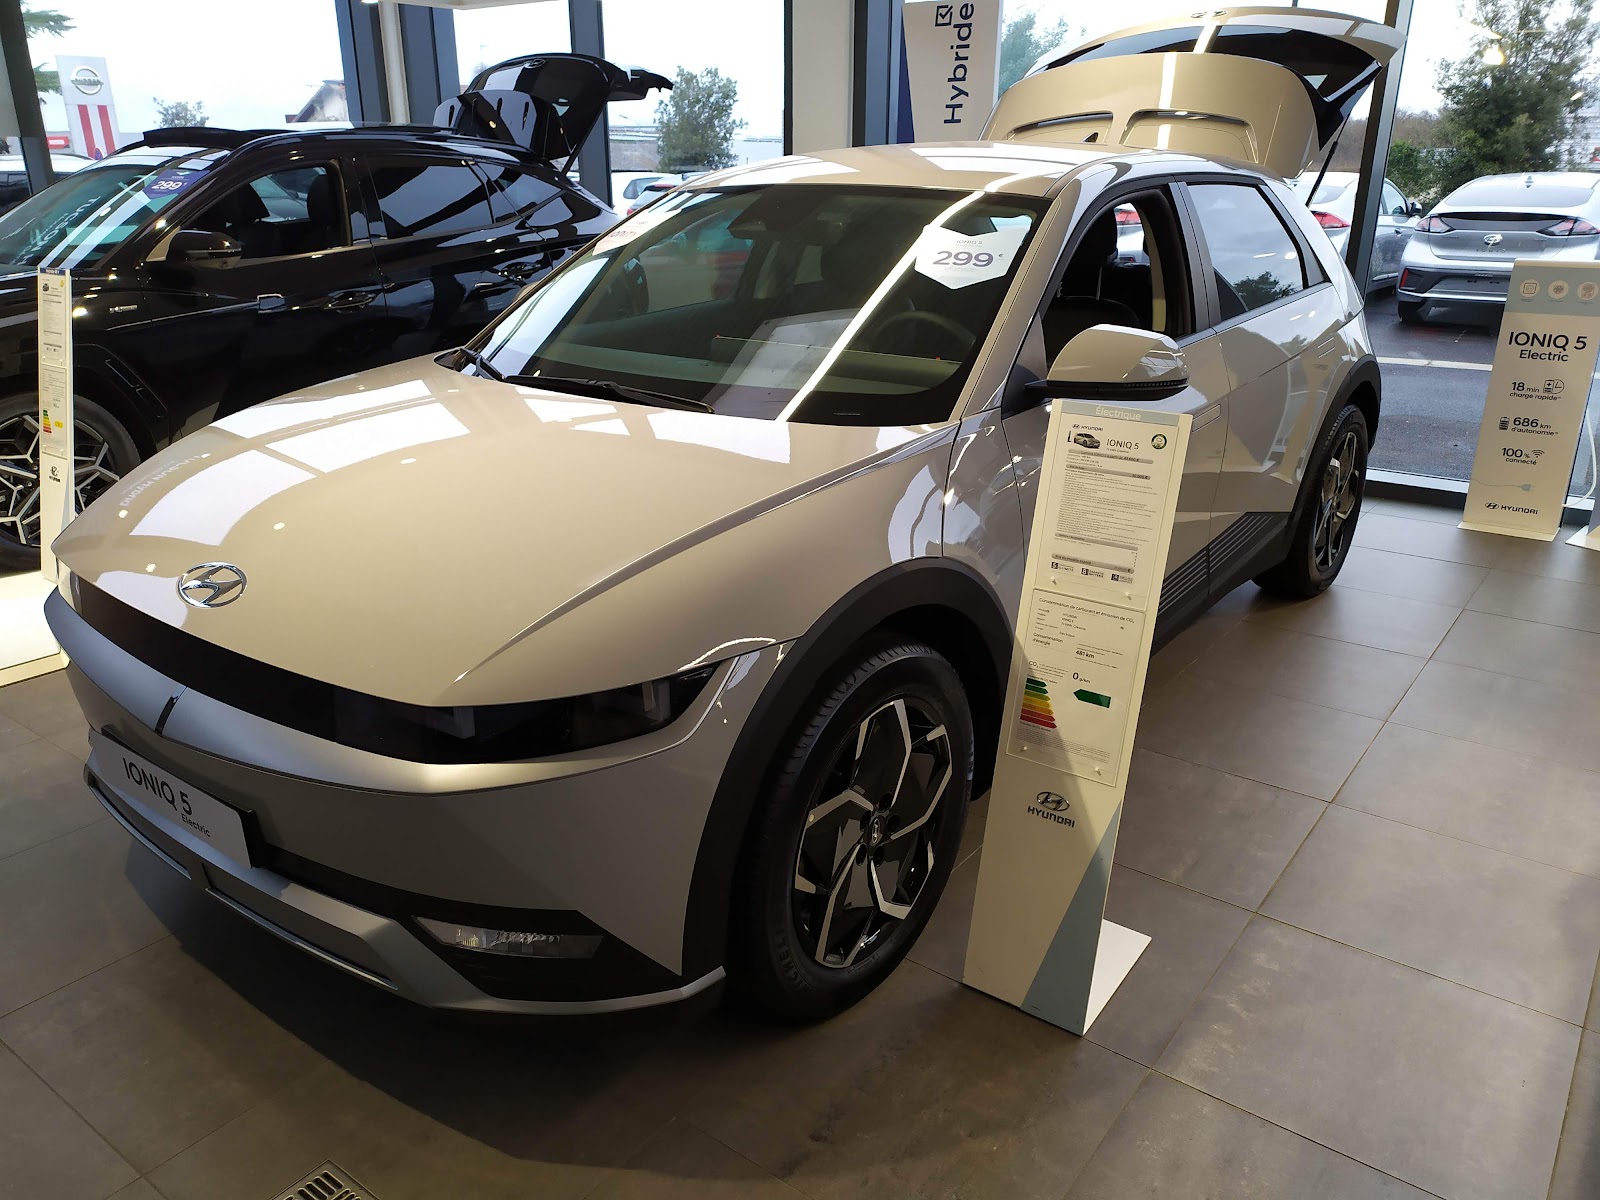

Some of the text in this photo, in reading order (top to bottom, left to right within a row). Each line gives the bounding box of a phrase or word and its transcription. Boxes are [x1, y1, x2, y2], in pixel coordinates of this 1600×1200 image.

[943, 2, 975, 124] Hybride
[151, 180, 182, 190] 299
[932, 251, 994, 267] 299
[1508, 331, 1588, 351] IONIQ 5
[1519, 349, 1569, 362] Electric
[1511, 381, 1525, 391] 18
[1509, 392, 1533, 400] charge
[1513, 416, 1539, 428] 686
[1106, 438, 1140, 450] IONIQ 5
[1502, 447, 1523, 458] 100
[1505, 457, 1537, 465] connecté
[1500, 504, 1539, 515] HYUNDAI
[1038, 597, 1069, 608] Consommation
[1033, 632, 1063, 643] Consommation
[1085, 651, 1095, 659] km
[1072, 672, 1079, 681] 0
[122, 757, 193, 816] IONIQ 5
[1027, 805, 1076, 828] HYUNDAI
[180, 812, 211, 838] Electric
